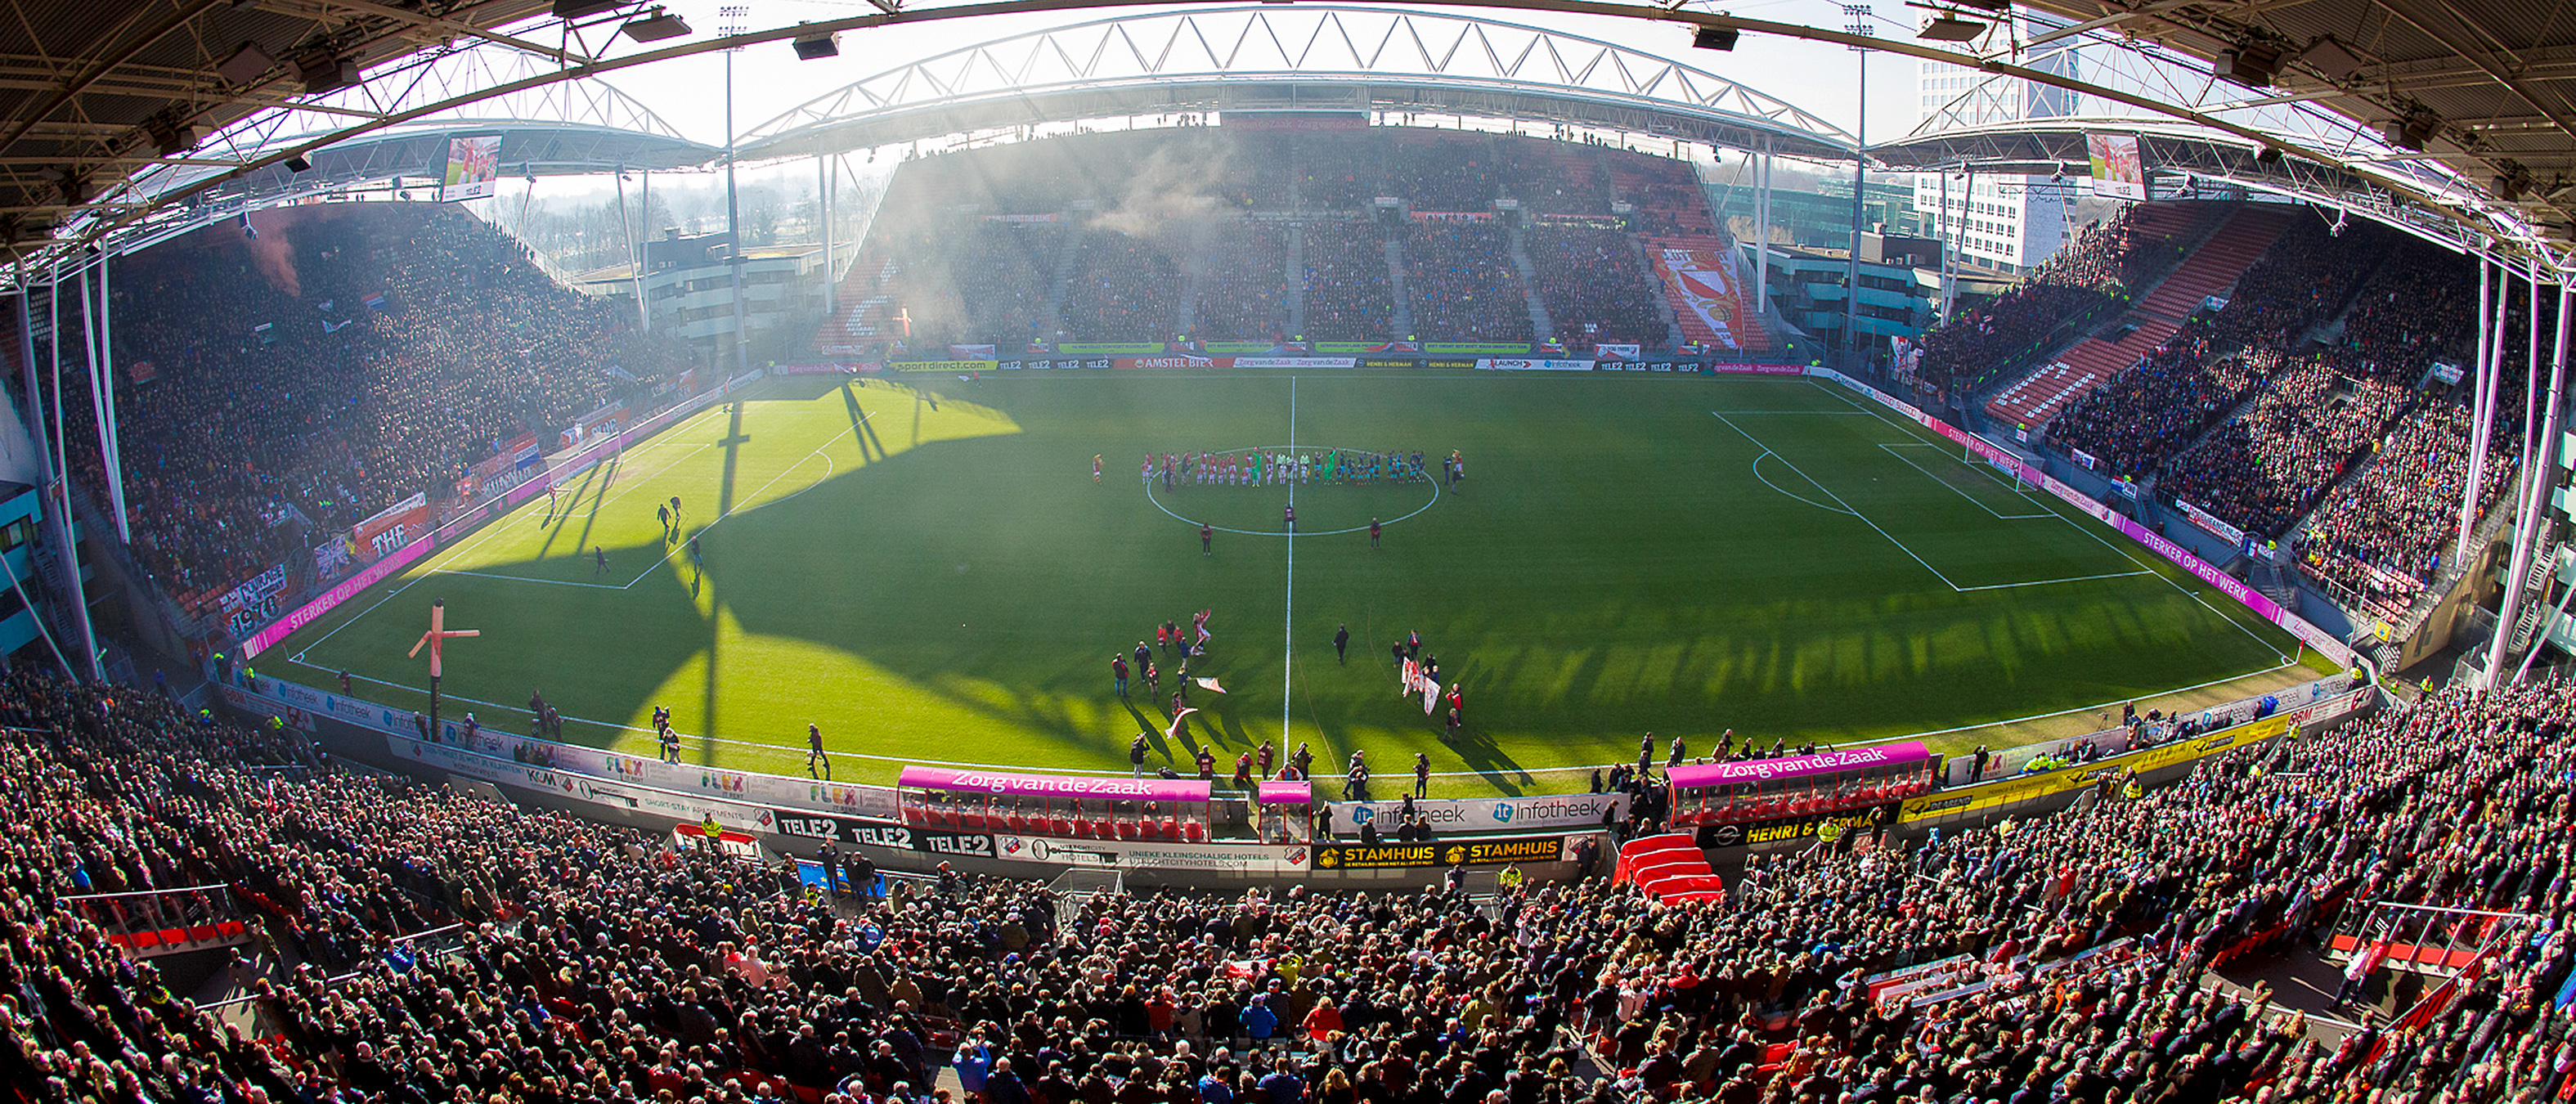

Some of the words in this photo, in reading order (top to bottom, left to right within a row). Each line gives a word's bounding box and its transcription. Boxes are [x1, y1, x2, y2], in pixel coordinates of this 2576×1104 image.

[999, 361, 1021, 370] TELE2
[1028, 361, 1050, 370] TELE2
[1057, 360, 1079, 369] TELE2
[1086, 359, 1109, 369] TELE2
[1146, 357, 1186, 368] AMSTEL
[1601, 362, 1622, 370] TELE2
[1625, 362, 1646, 370] TELE2
[1650, 362, 1672, 371] TELE2
[1949, 428, 1975, 447] STERKR
[1985, 447, 1999, 459] HET
[371, 523, 407, 559] THE
[2143, 532, 2182, 563] STERKER
[2183, 556, 2197, 570] OP
[2198, 562, 2219, 584] HET
[2219, 574, 2248, 602] WERK
[289, 595, 335, 629] STERKER
[336, 584, 352, 601] OP
[352, 575, 373, 593] HET
[373, 557, 403, 581] WERK
[2293, 619, 2312, 641] Zorg
[606, 756, 644, 777] FLEX
[1718, 763, 1771, 779] Zorg
[1770, 757, 1812, 773] van
[1811, 753, 1835, 769] de
[1835, 747, 1887, 765] Zaak
[702, 771, 744, 792] FLEX
[952, 771, 1006, 792] Zorg
[1010, 778, 1055, 791] van
[1058, 778, 1088, 793] de
[1088, 779, 1153, 796] Zaak
[644, 797, 689, 812] SHORT-STAY
[810, 785, 857, 806] FLEX
[1942, 796, 1972, 809] AREND
[1376, 805, 1465, 824] Inftheek
[1516, 798, 1601, 820] Infotheek
[781, 819, 841, 841] TELE2
[852, 828, 914, 850] TELE2
[1746, 823, 1800, 843] HENRI
[1802, 822, 1815, 837] &
[927, 835, 992, 857] TELE2
[1129, 850, 1161, 859] UNIEKE
[1162, 851, 1232, 859] KLEINSCHALIGE
[1344, 846, 1435, 861] STAMHUIS
[1470, 841, 1558, 857] STAMHUIS
[1061, 854, 1099, 862] HOTELS
